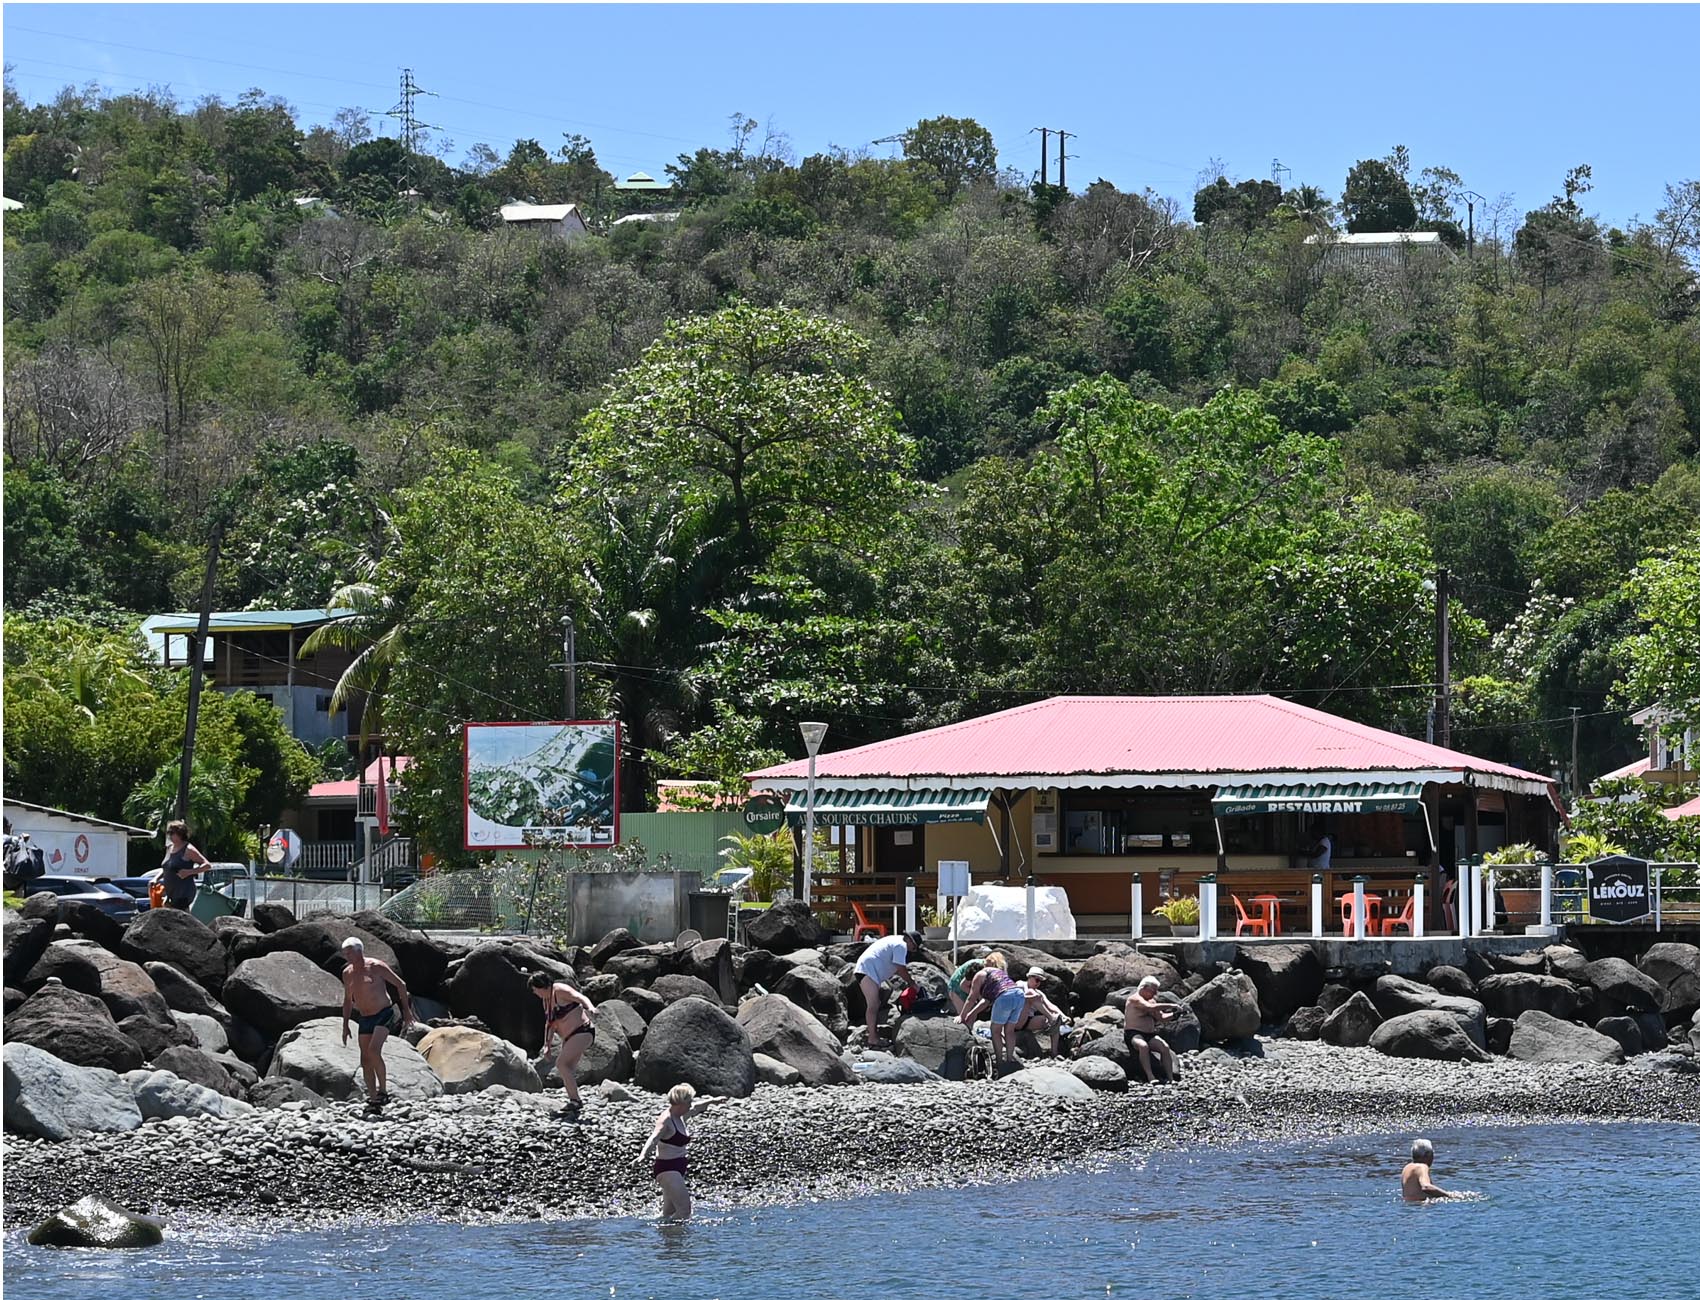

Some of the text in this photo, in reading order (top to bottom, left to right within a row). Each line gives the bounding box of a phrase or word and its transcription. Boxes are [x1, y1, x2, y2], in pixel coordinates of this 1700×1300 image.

[1267, 801, 1363, 813] RESTAURANT
[746, 811, 780, 823] Corsaire
[822, 814, 867, 825] SOURCES
[870, 813, 918, 825] CHAUDES
